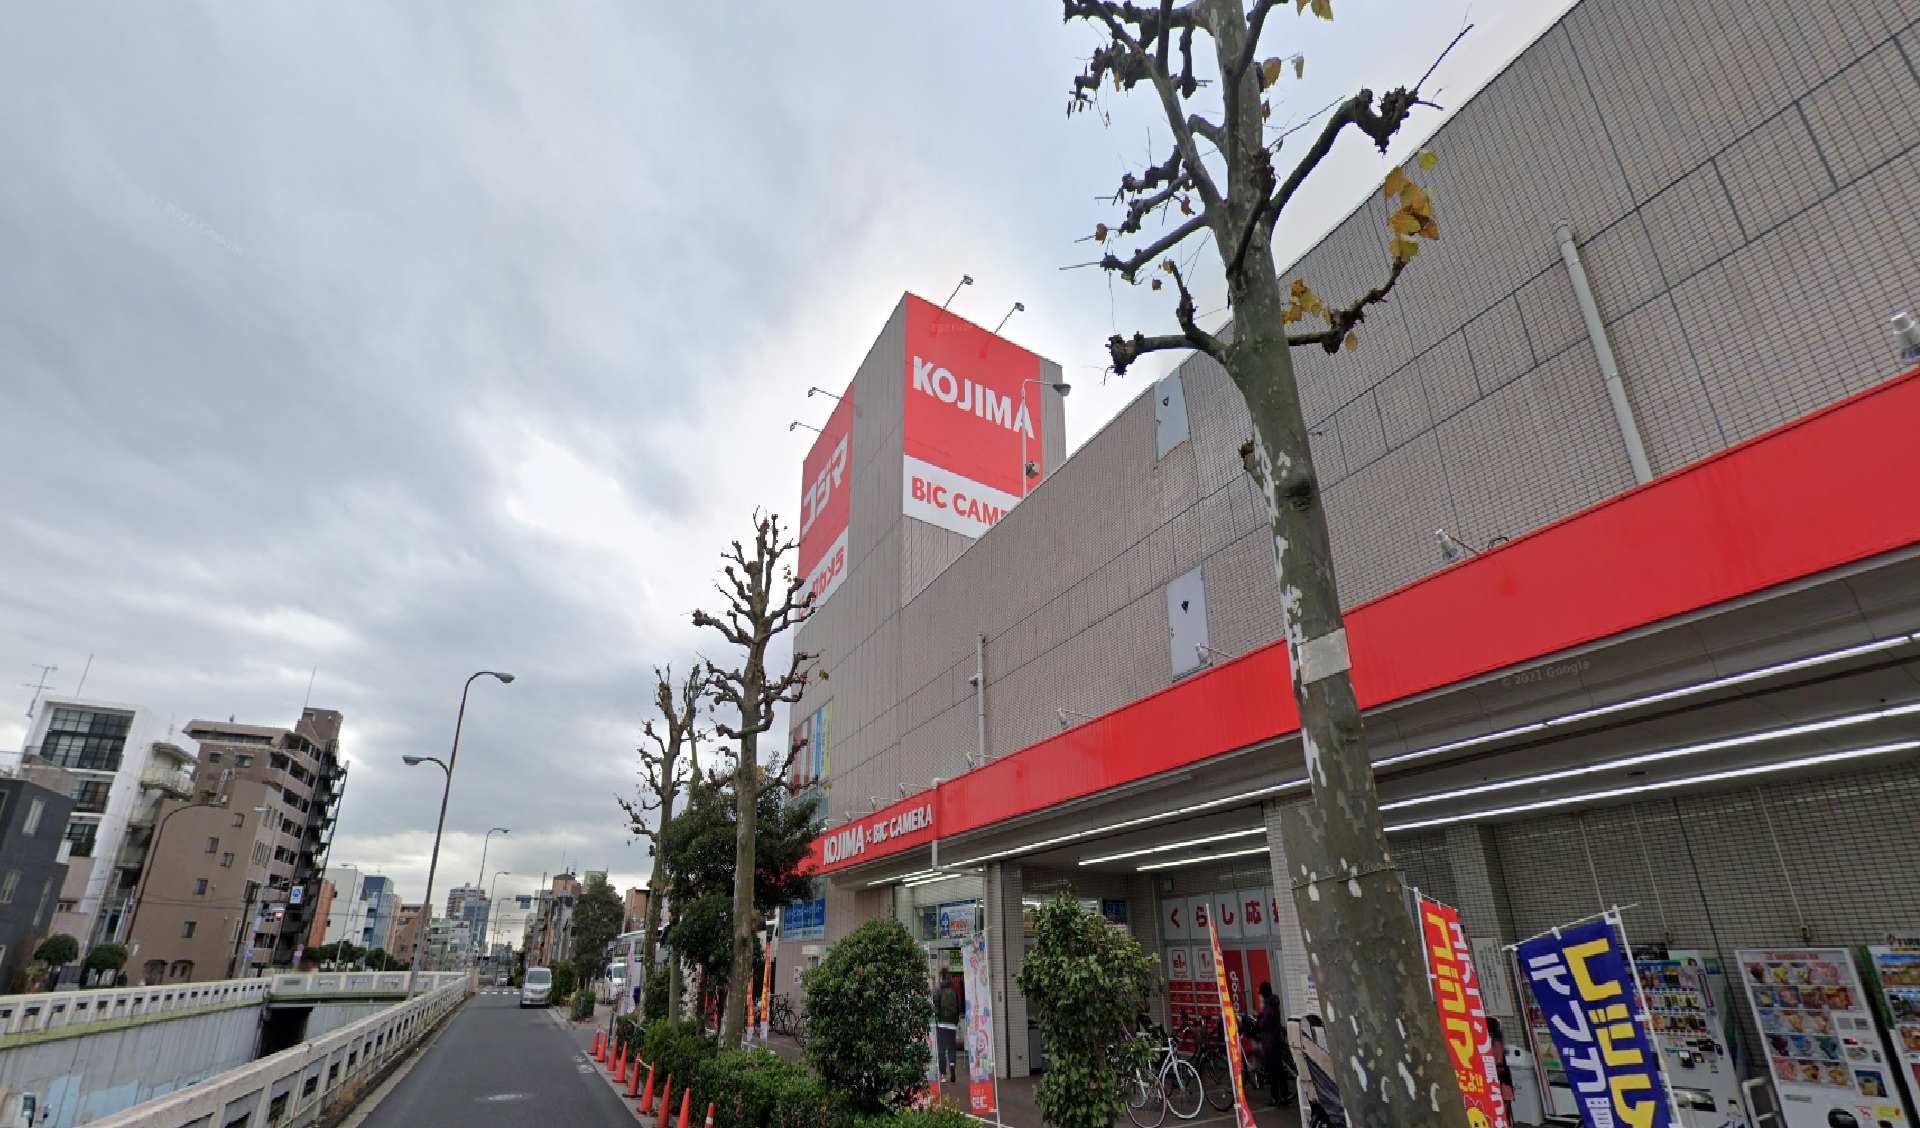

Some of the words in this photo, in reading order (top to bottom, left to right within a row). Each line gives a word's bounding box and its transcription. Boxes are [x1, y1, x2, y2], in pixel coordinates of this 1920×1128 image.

[913, 355, 1034, 440] KOJIMA
[802, 432, 848, 537] コジマ
[911, 475, 948, 509] BIC
[823, 824, 865, 866] KOJIMA
[873, 819, 889, 844] BIC
[890, 803, 933, 838] CAMERA
[1427, 912, 1475, 1069] コジマ
